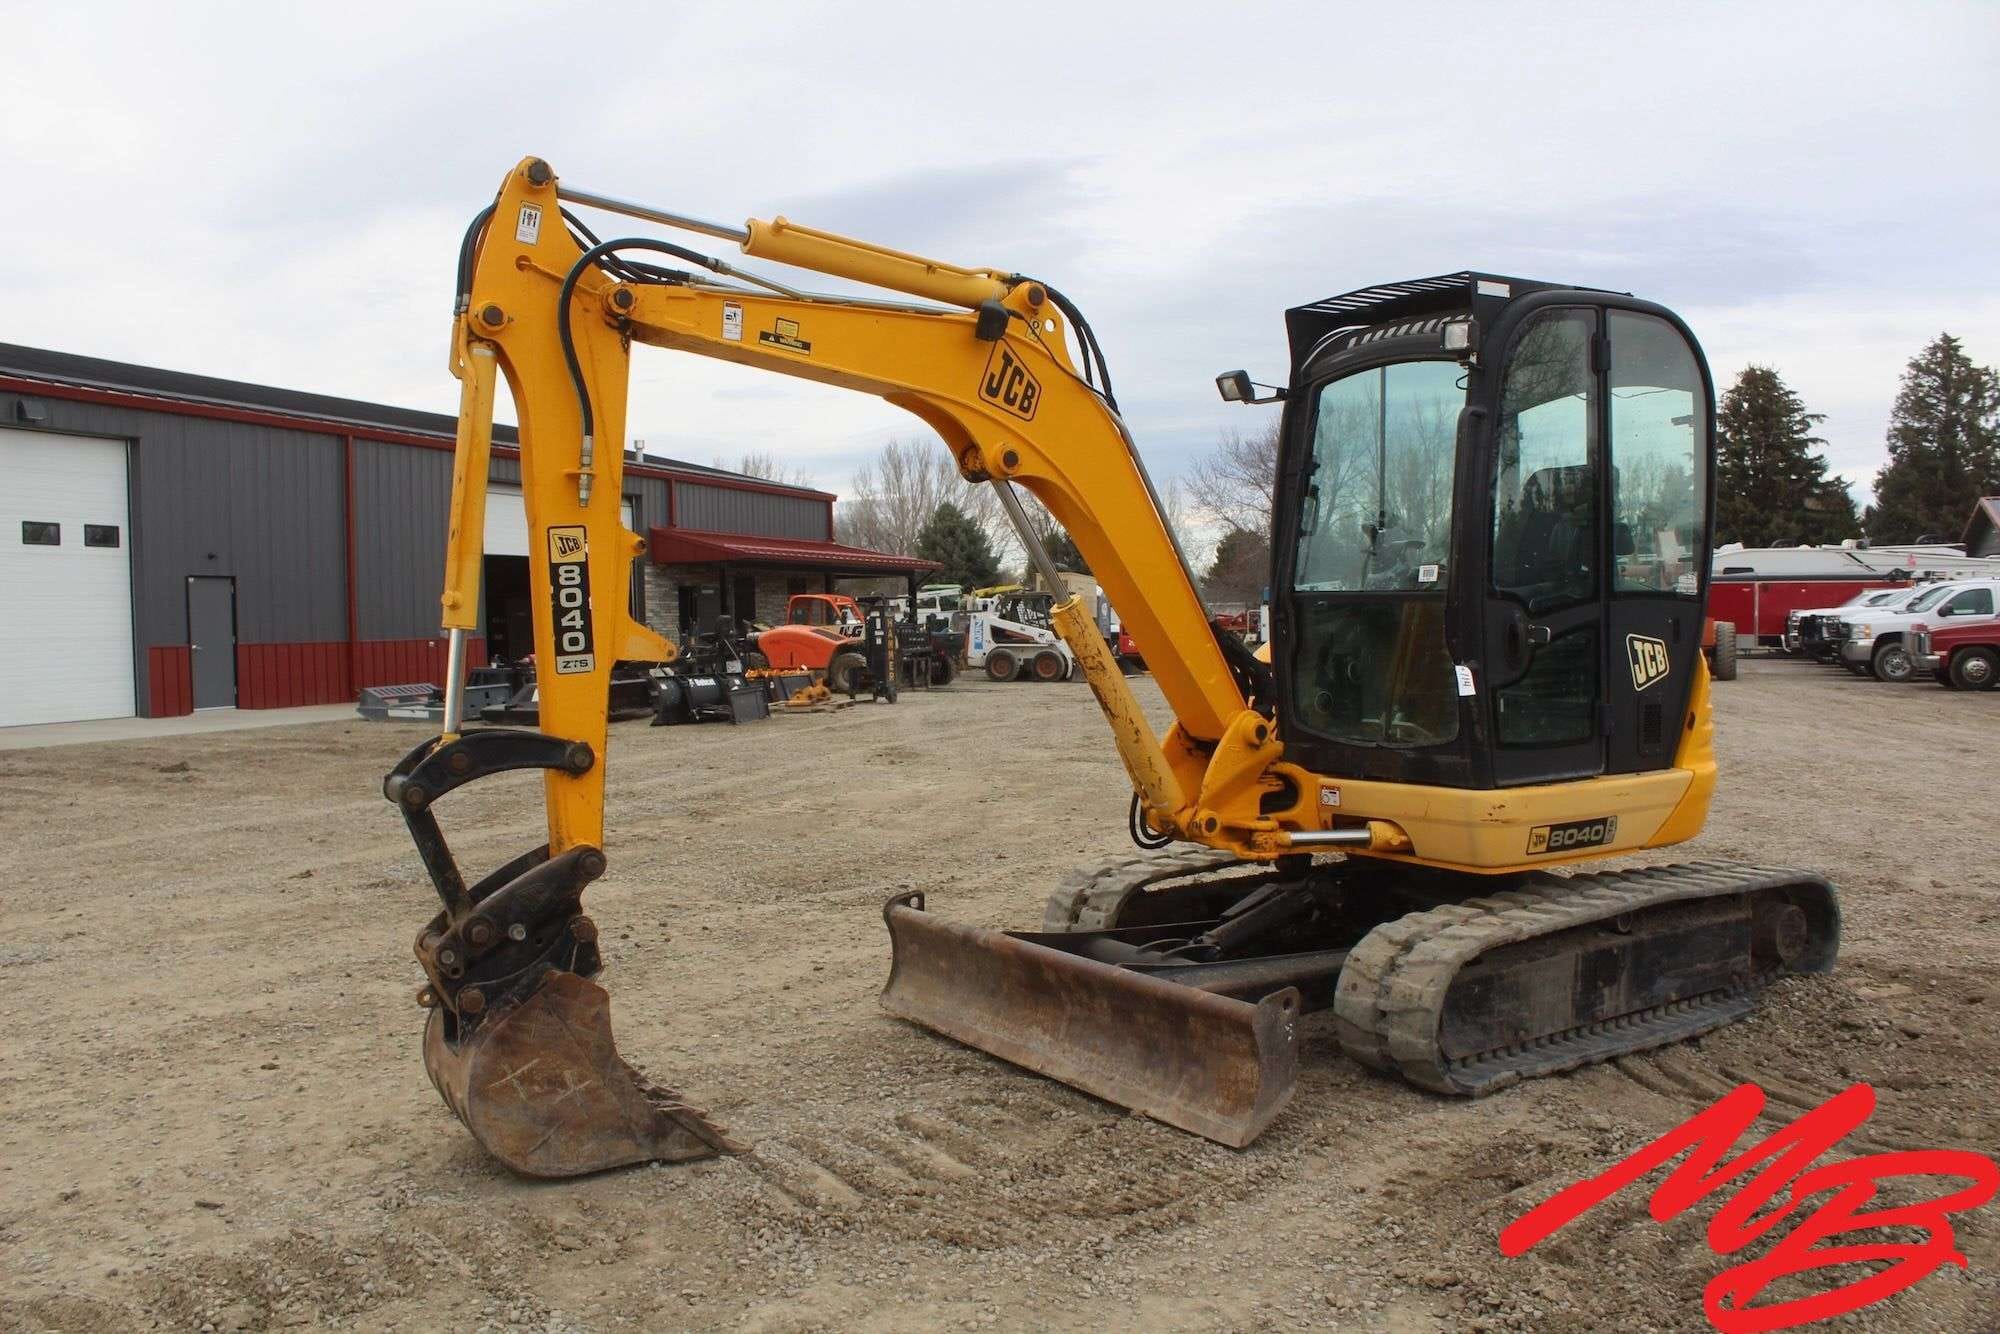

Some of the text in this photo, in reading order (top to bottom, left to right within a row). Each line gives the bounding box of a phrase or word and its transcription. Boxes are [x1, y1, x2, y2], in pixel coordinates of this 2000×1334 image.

[985, 350, 1036, 414] JCB
[557, 536, 580, 555] JCB
[558, 565, 585, 652] 8040
[562, 660, 588, 669] ZTS
[1633, 640, 1666, 684] JCB
[1549, 825, 1604, 847] 8040
